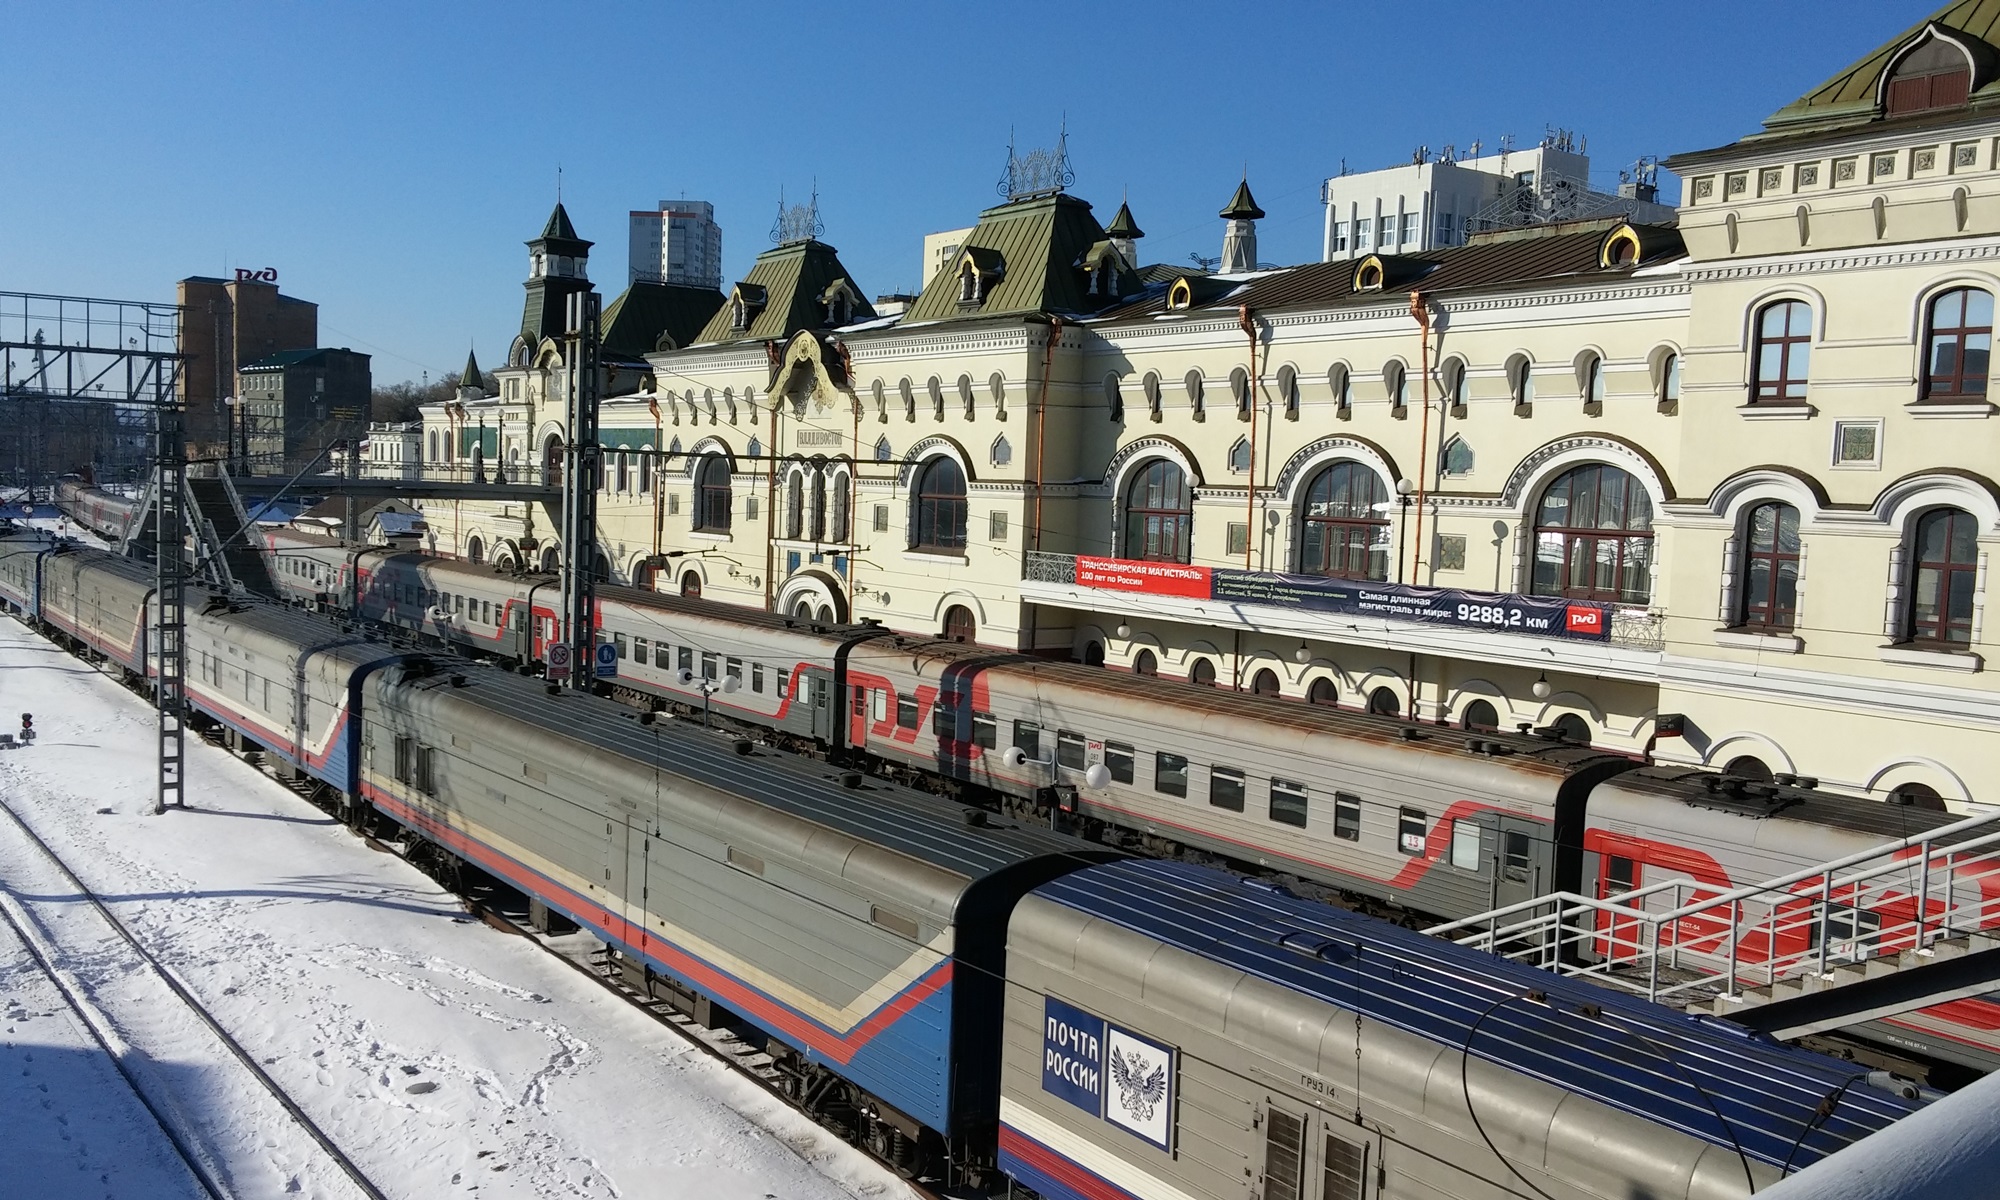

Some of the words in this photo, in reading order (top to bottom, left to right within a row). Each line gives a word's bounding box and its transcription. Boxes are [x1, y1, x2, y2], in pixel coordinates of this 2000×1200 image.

[1081, 560, 1147, 575] ТРАНССИБИРСКАЯ
[1148, 566, 1203, 580] МАГИСТРАЛЬ:
[1081, 571, 1094, 580] 100
[1117, 575, 1143, 586] России
[1358, 590, 1389, 602] Самая
[1389, 595, 1431, 606] длинная
[1358, 602, 1413, 614] магистраль
[1422, 608, 1452, 618] мире:
[1457, 603, 1522, 628] 9288,2
[1407, 835, 1419, 848] 13
[1047, 1016, 1099, 1063] ПОЧТА
[1046, 1048, 1099, 1095] РОССИИ
[1301, 1074, 1324, 1093] ГРУЗ
